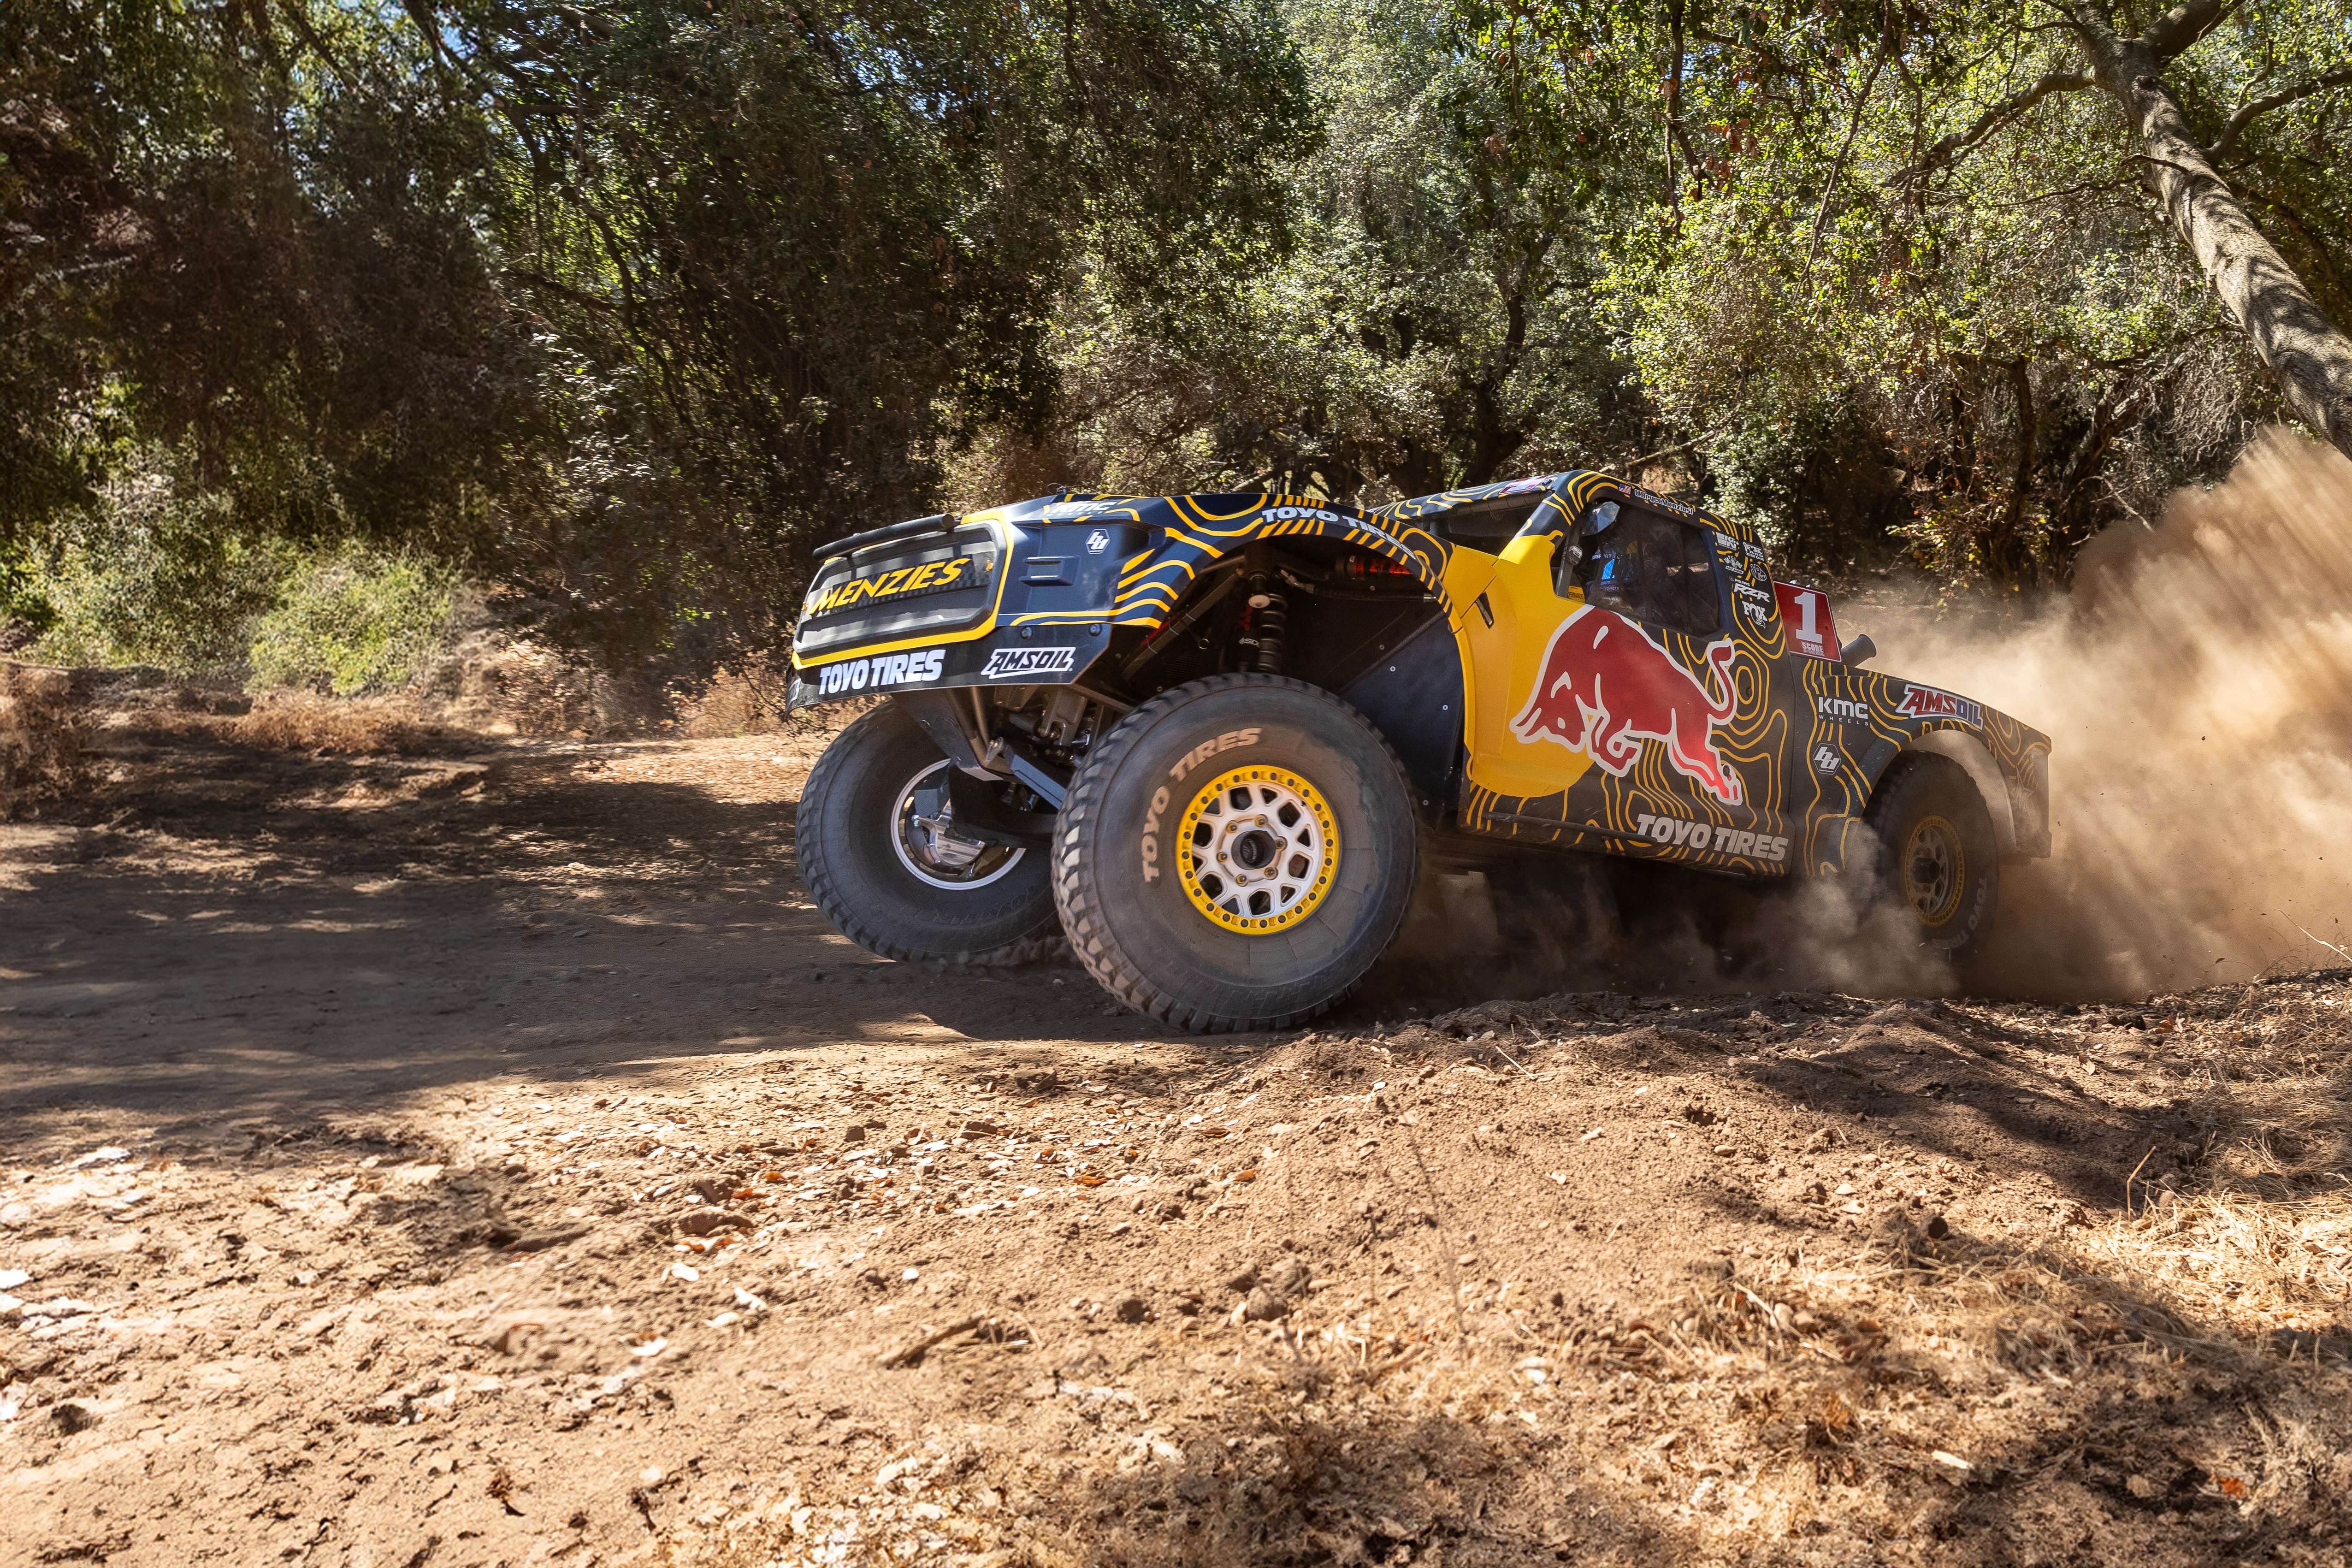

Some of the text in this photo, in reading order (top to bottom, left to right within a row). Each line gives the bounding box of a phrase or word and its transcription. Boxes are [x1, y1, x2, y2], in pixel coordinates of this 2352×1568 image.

[1262, 507, 1416, 560] TOYO TIRES
[809, 558, 970, 615] MENZIES
[1734, 583, 1770, 603] RZR
[1742, 601, 1767, 628] FOX
[1794, 591, 1822, 644] 1
[982, 648, 1075, 678] AMSOIL
[1802, 642, 1824, 653] SCORE
[819, 659, 869, 695] TOYO
[870, 650, 946, 686] TIRES
[1819, 715, 1868, 726] WHEELS
[1898, 686, 1982, 728] AMSOIL
[1141, 728, 1262, 882] TOYO TIRES
[1637, 814, 1789, 861] TOYO TIRES
